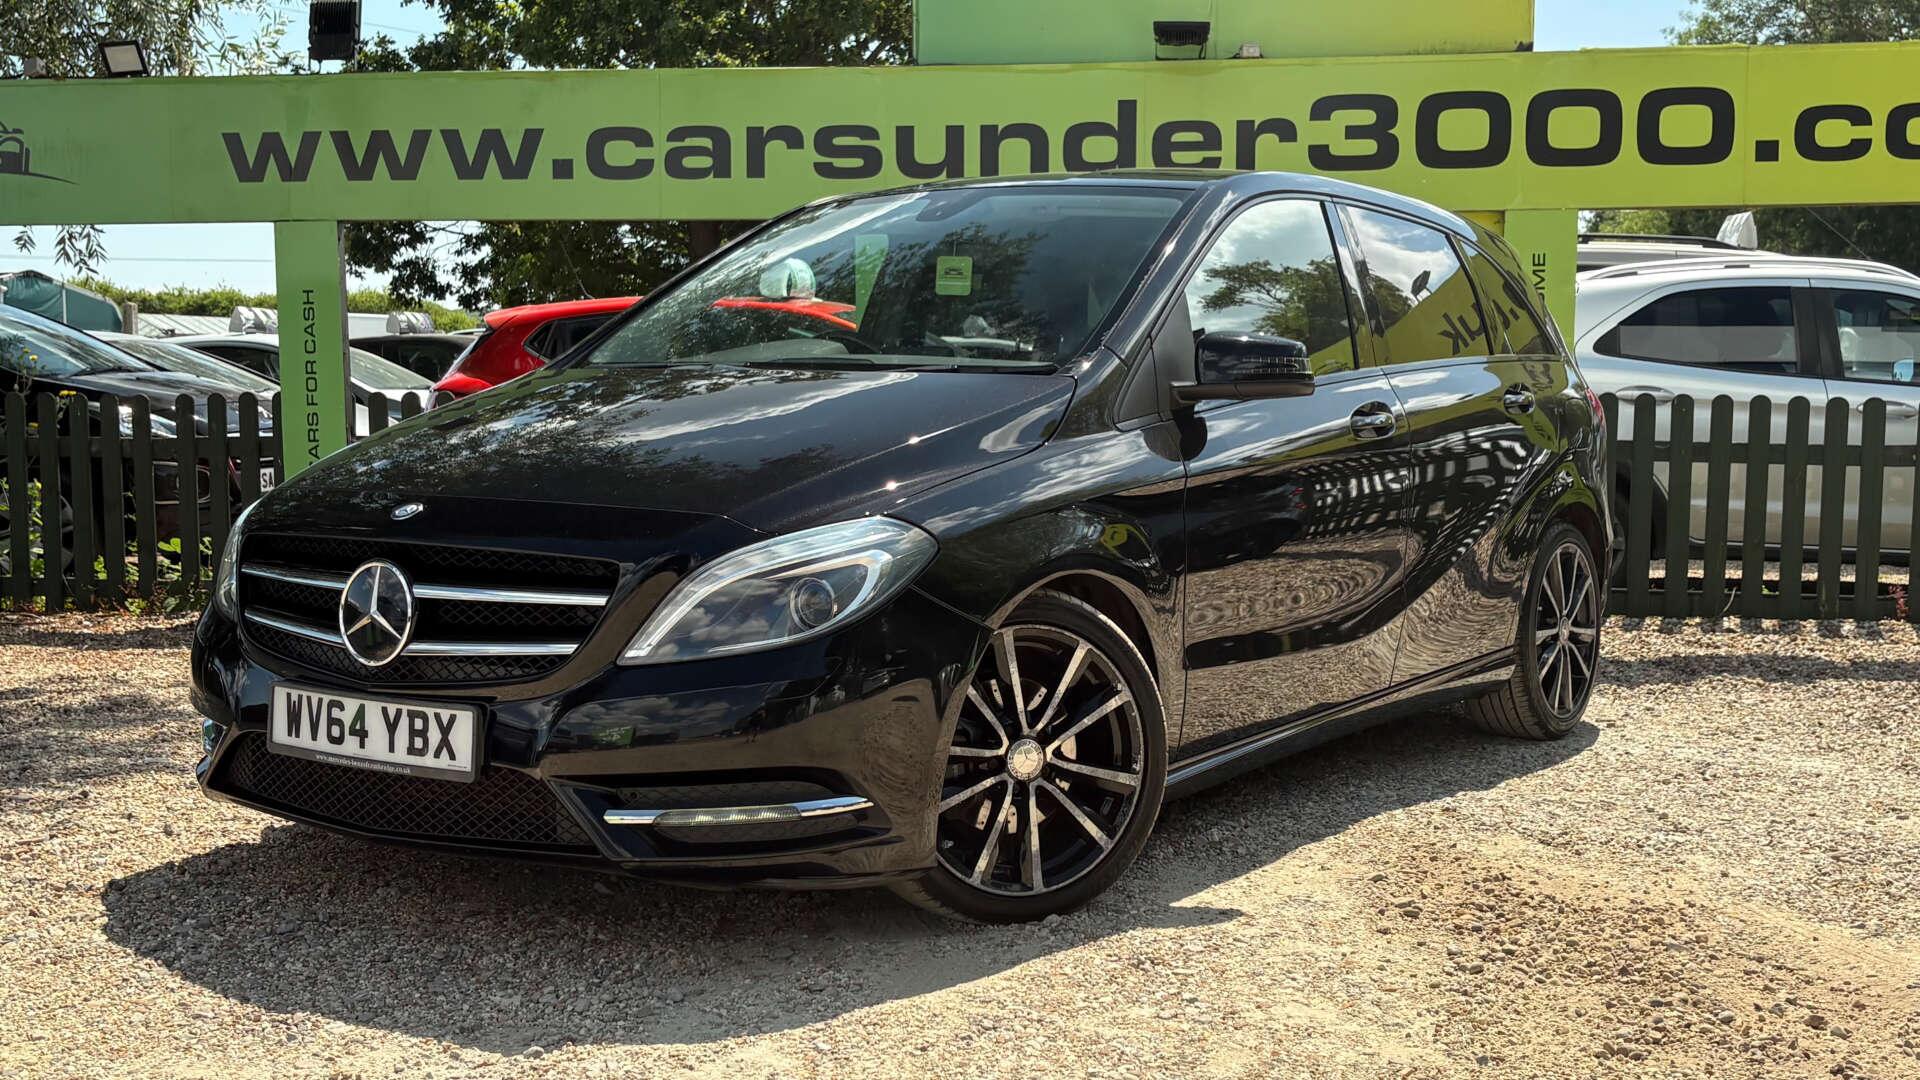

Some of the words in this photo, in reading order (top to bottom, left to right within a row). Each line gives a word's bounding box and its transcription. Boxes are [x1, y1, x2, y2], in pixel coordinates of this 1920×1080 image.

[302, 289, 316, 354] CASH
[305, 360, 318, 406] FOR
[308, 412, 320, 466] ARS
[286, 692, 368, 749] WV64
[381, 705, 457, 761] YBX
